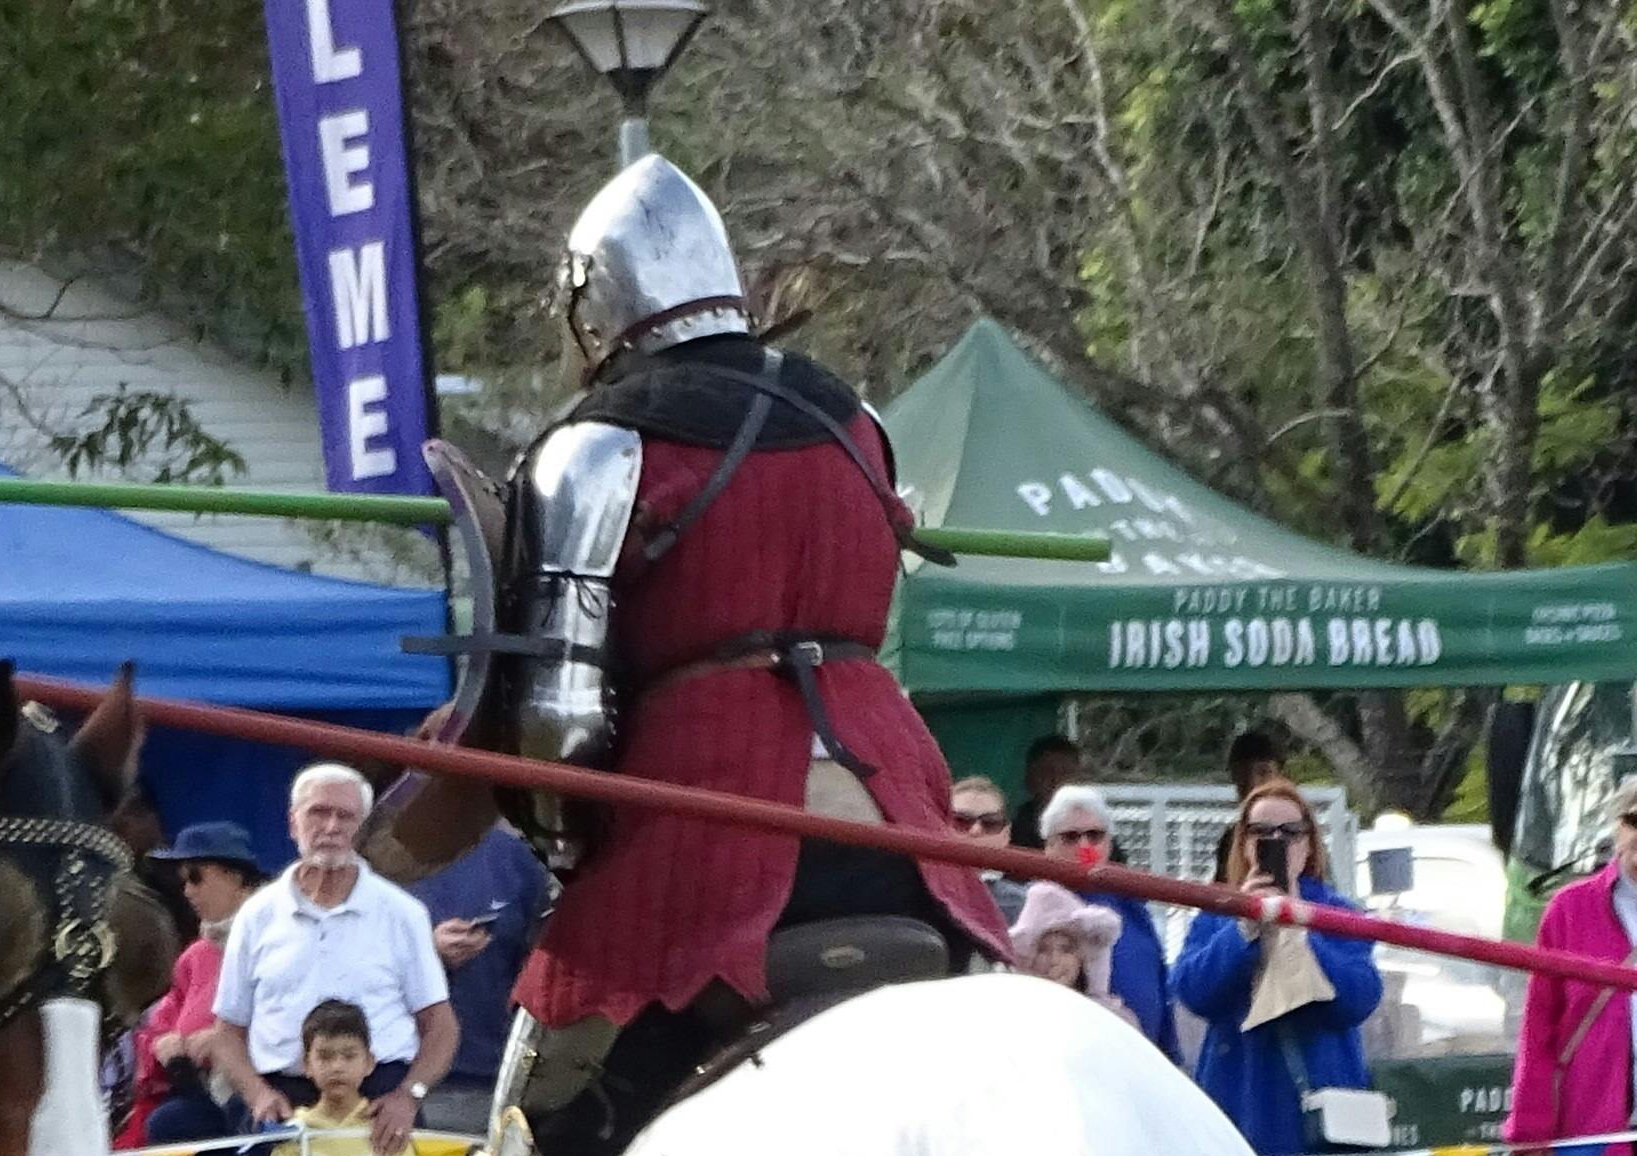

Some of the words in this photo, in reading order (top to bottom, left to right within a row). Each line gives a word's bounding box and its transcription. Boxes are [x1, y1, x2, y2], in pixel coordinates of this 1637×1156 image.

[1173, 586, 1247, 613] PADDY
[1258, 585, 1298, 611] THE
[1309, 584, 1381, 611] BAKER
[1109, 620, 1210, 669] IRISH
[1223, 618, 1314, 667] SODA
[1327, 617, 1443, 667] BREAD
